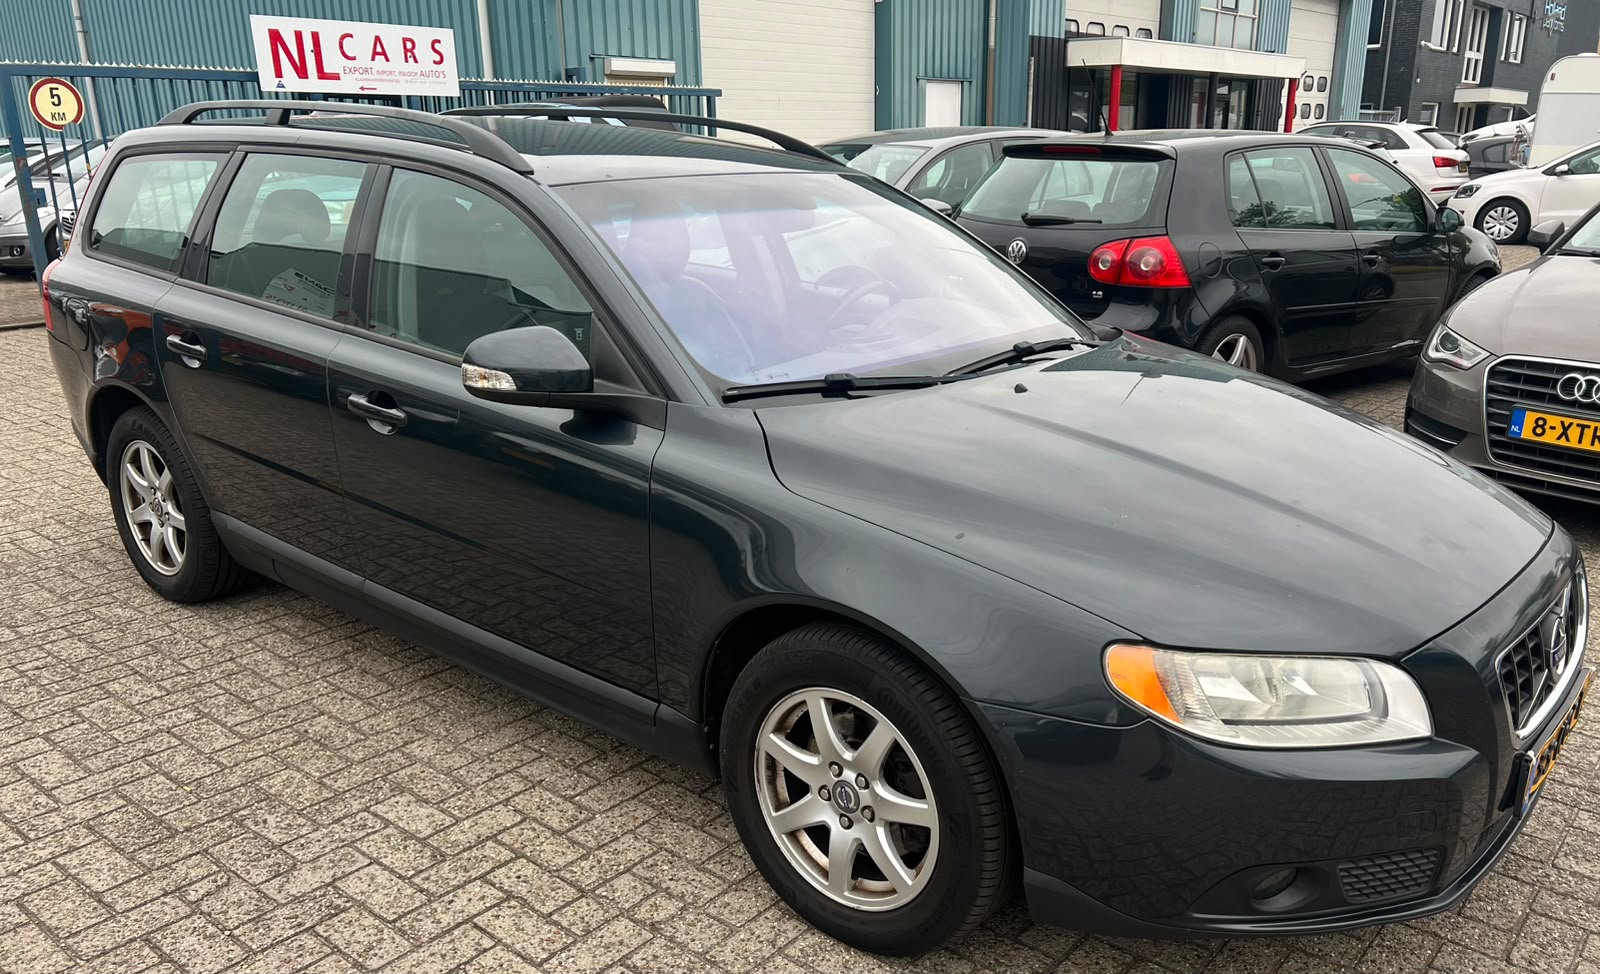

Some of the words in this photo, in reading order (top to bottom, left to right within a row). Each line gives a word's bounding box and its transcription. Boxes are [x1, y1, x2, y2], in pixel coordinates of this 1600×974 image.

[267, 28, 341, 81] NL
[338, 33, 444, 65] CARS
[343, 66, 375, 76] EXPORT,
[420, 70, 447, 78] AUTO'S
[49, 87, 61, 106] 5
[51, 112, 67, 121] KM
